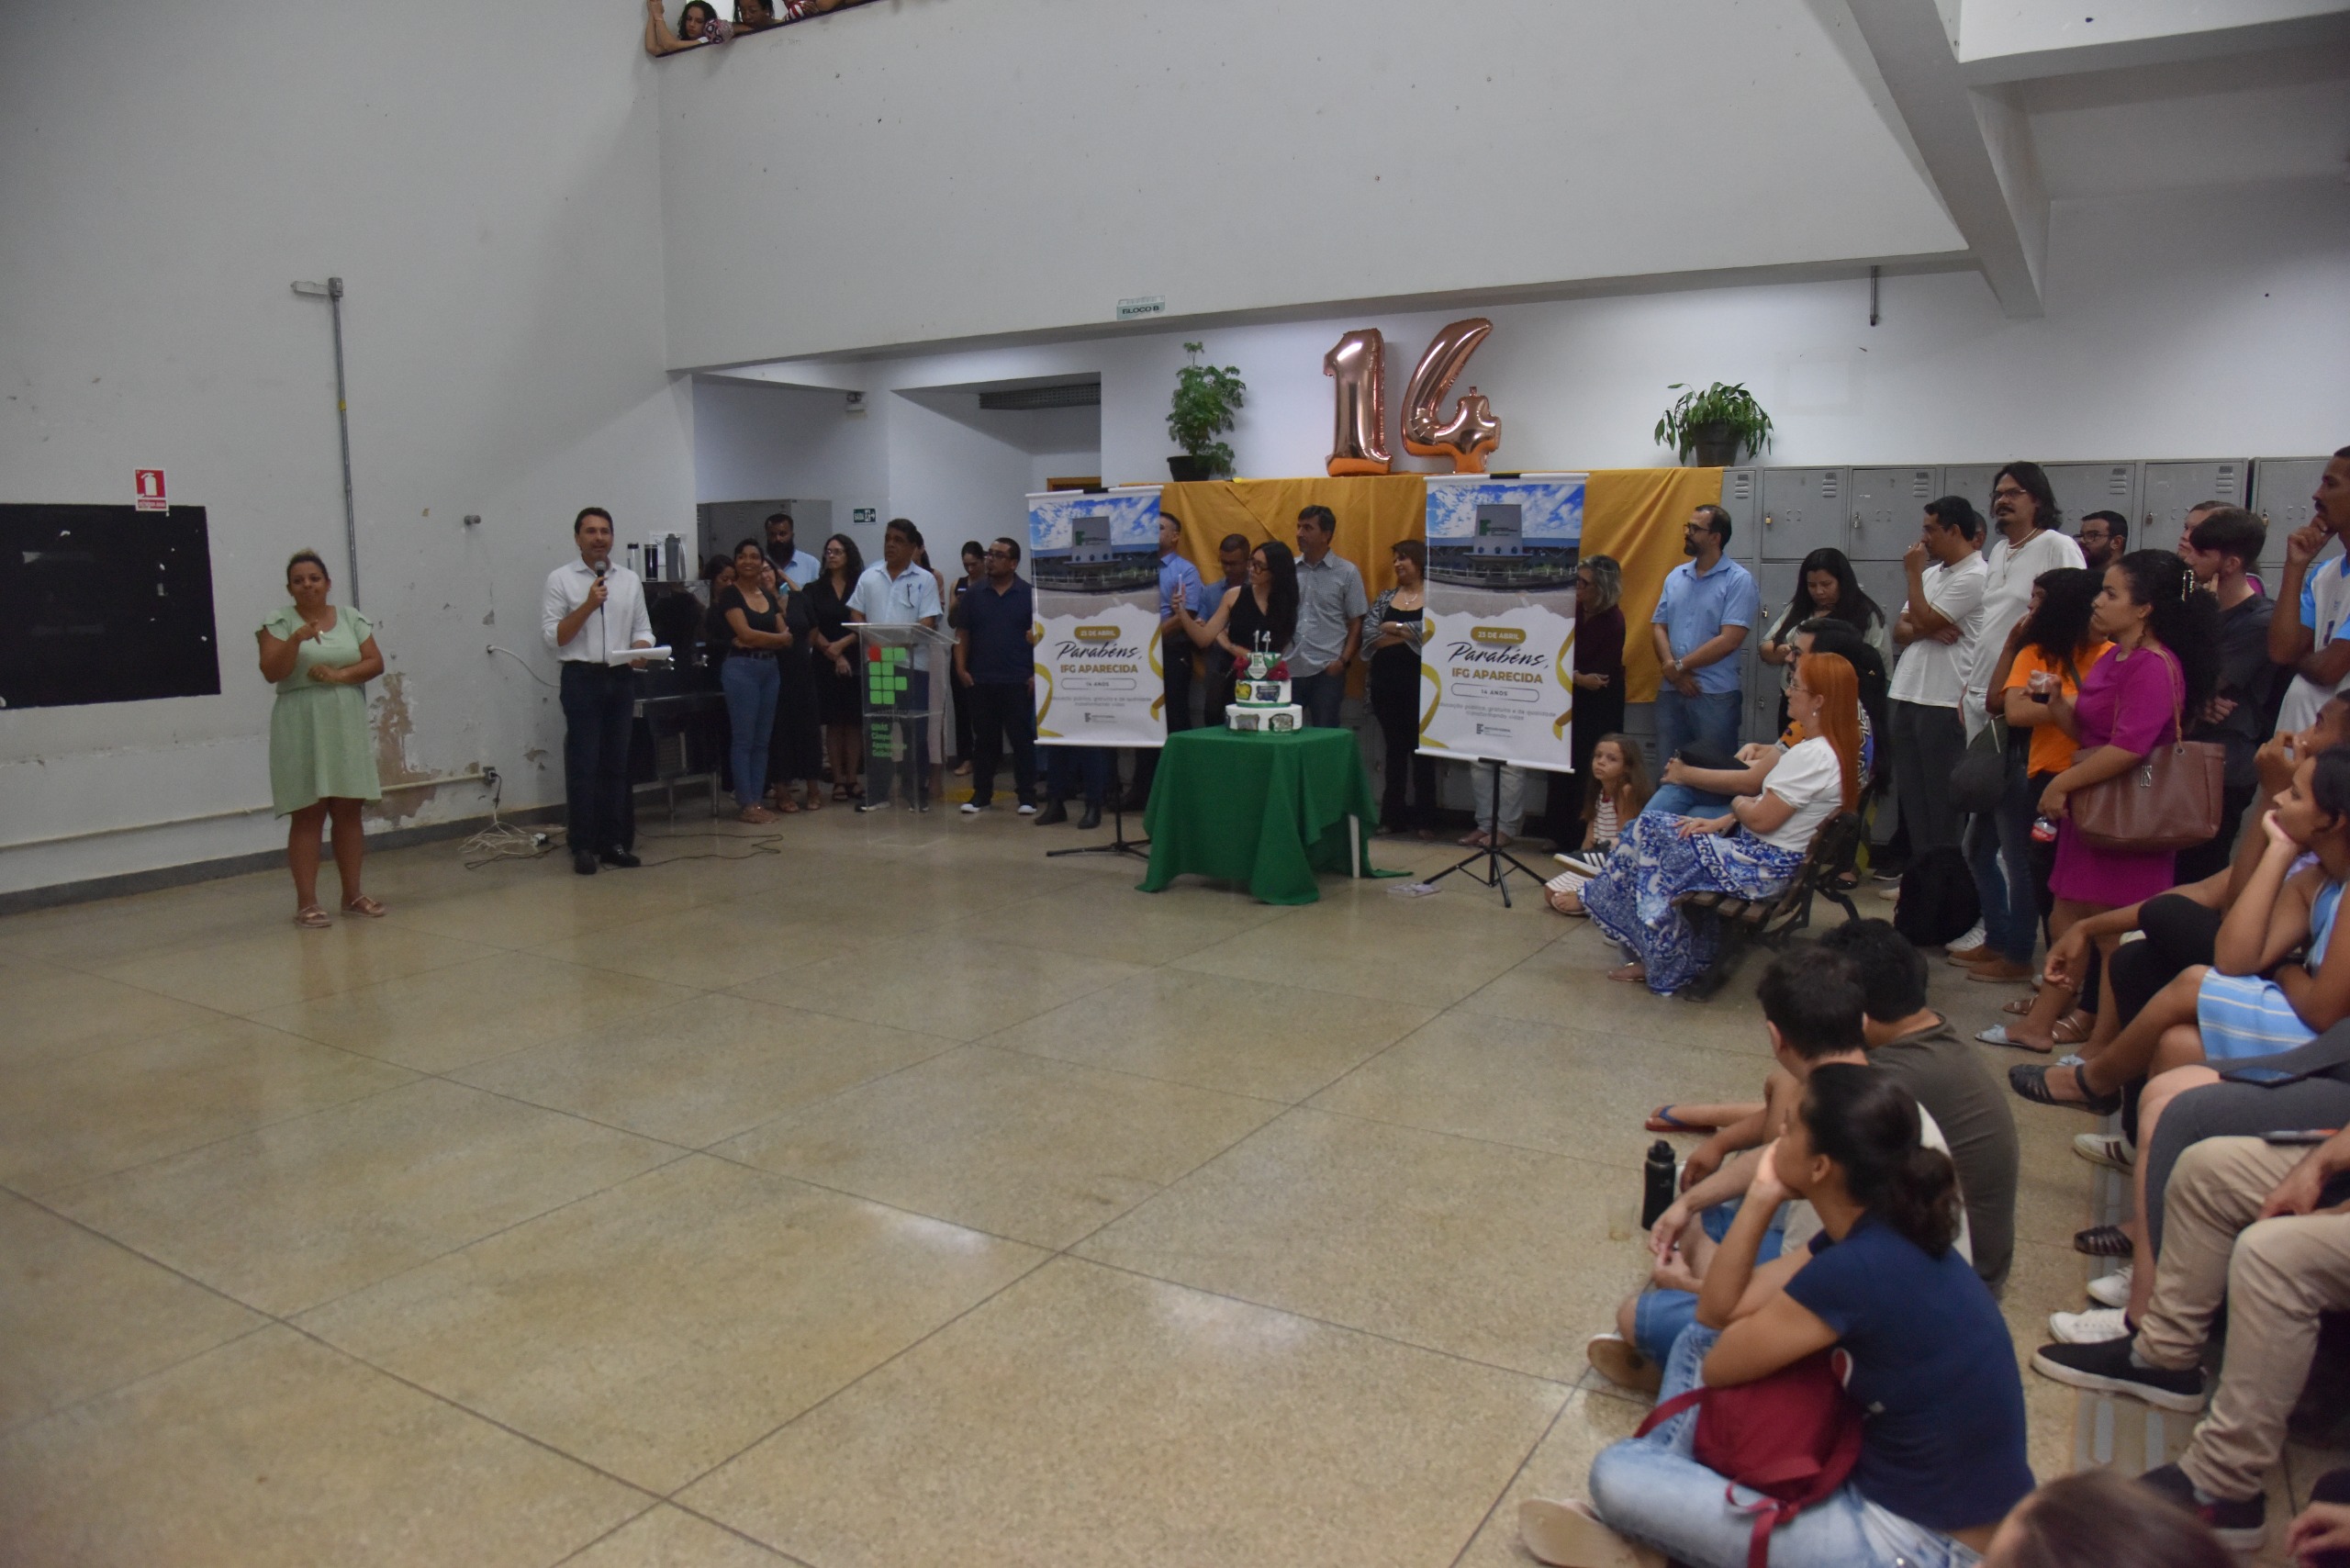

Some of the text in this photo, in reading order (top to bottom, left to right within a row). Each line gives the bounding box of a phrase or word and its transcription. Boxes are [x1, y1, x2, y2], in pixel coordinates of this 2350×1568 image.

[1055, 641, 1143, 660] Parabéns,
[1447, 642, 1549, 669] Parabéns,
[1060, 664, 1138, 674] IFG APARECIDA
[1451, 667, 1543, 684] IFG APARECIDA
